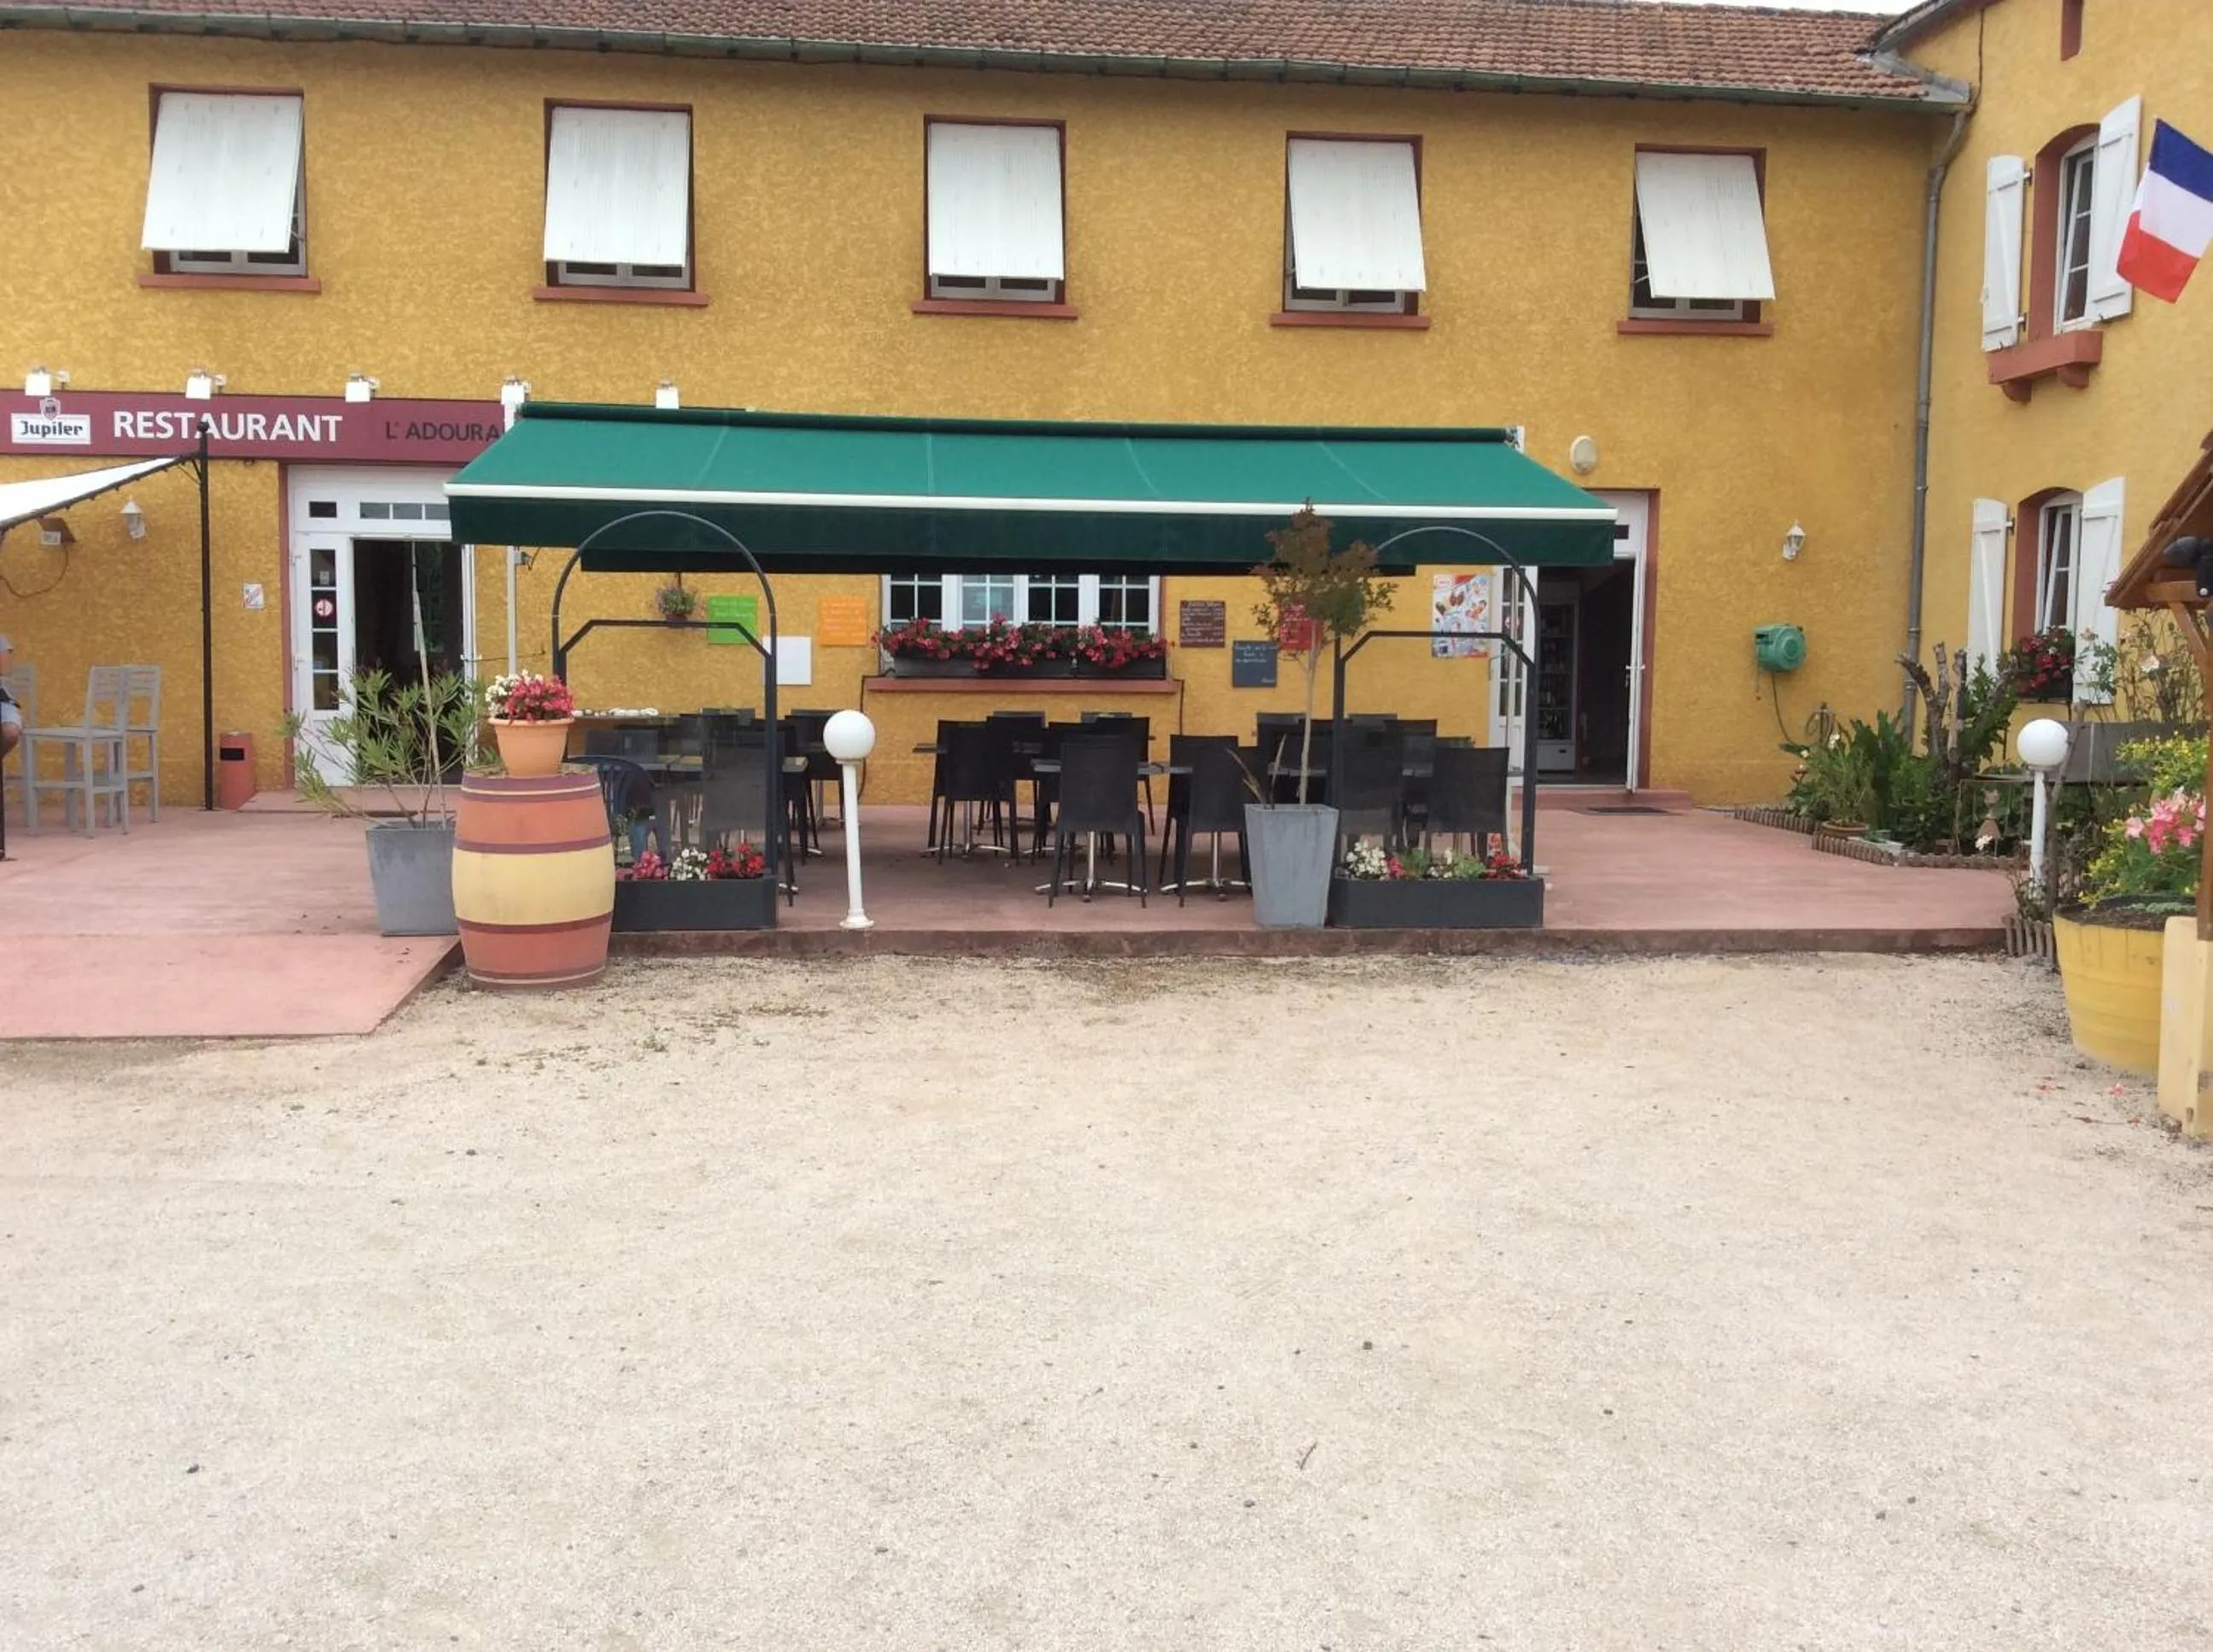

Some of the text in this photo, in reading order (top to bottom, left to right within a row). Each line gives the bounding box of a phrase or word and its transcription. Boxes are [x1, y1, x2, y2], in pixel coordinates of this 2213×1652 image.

[20, 420, 84, 438] Jupiler
[114, 411, 342, 442] RESTAURANT
[406, 422, 504, 442] ADOURA
